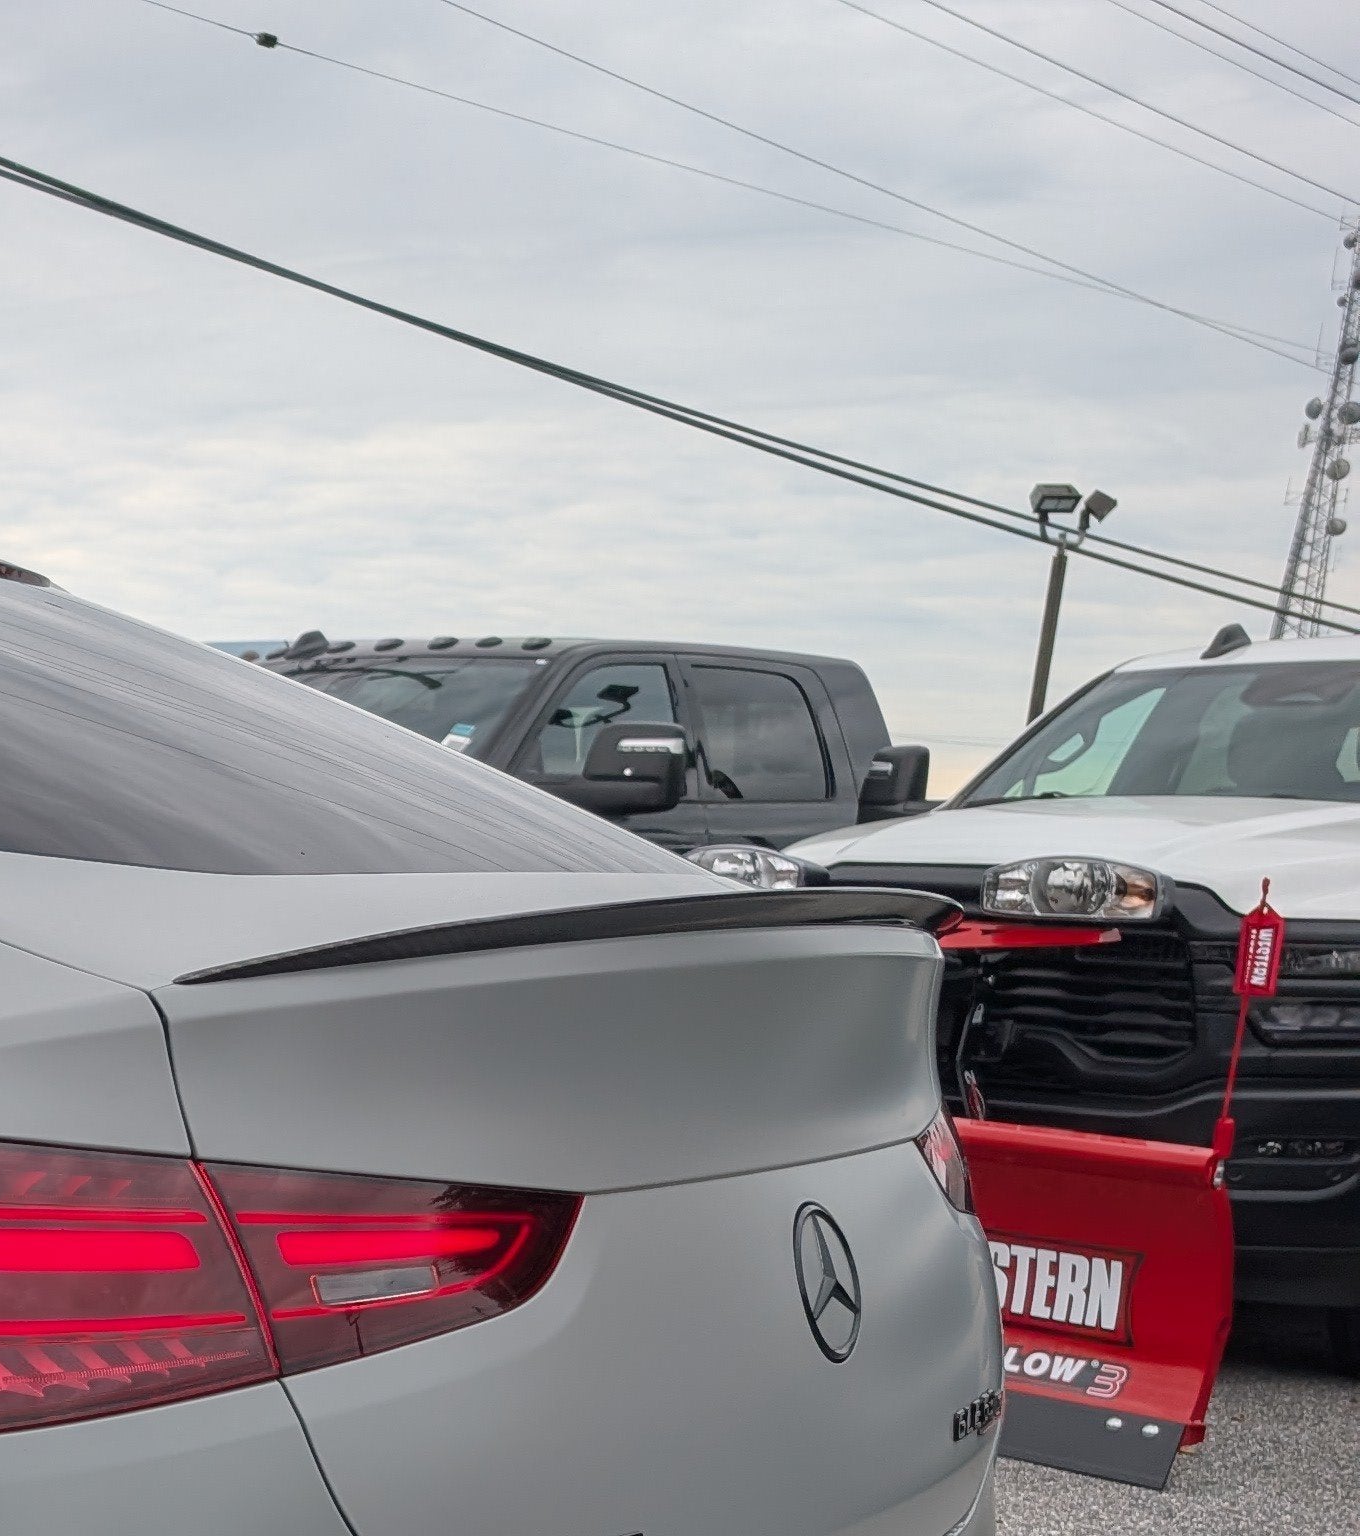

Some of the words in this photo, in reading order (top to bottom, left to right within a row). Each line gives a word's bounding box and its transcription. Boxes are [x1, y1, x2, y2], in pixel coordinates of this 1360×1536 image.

[987, 1240, 1123, 1331] STERN
[1003, 1347, 1087, 1383] LOW
[1086, 1363, 1128, 1398] 3
